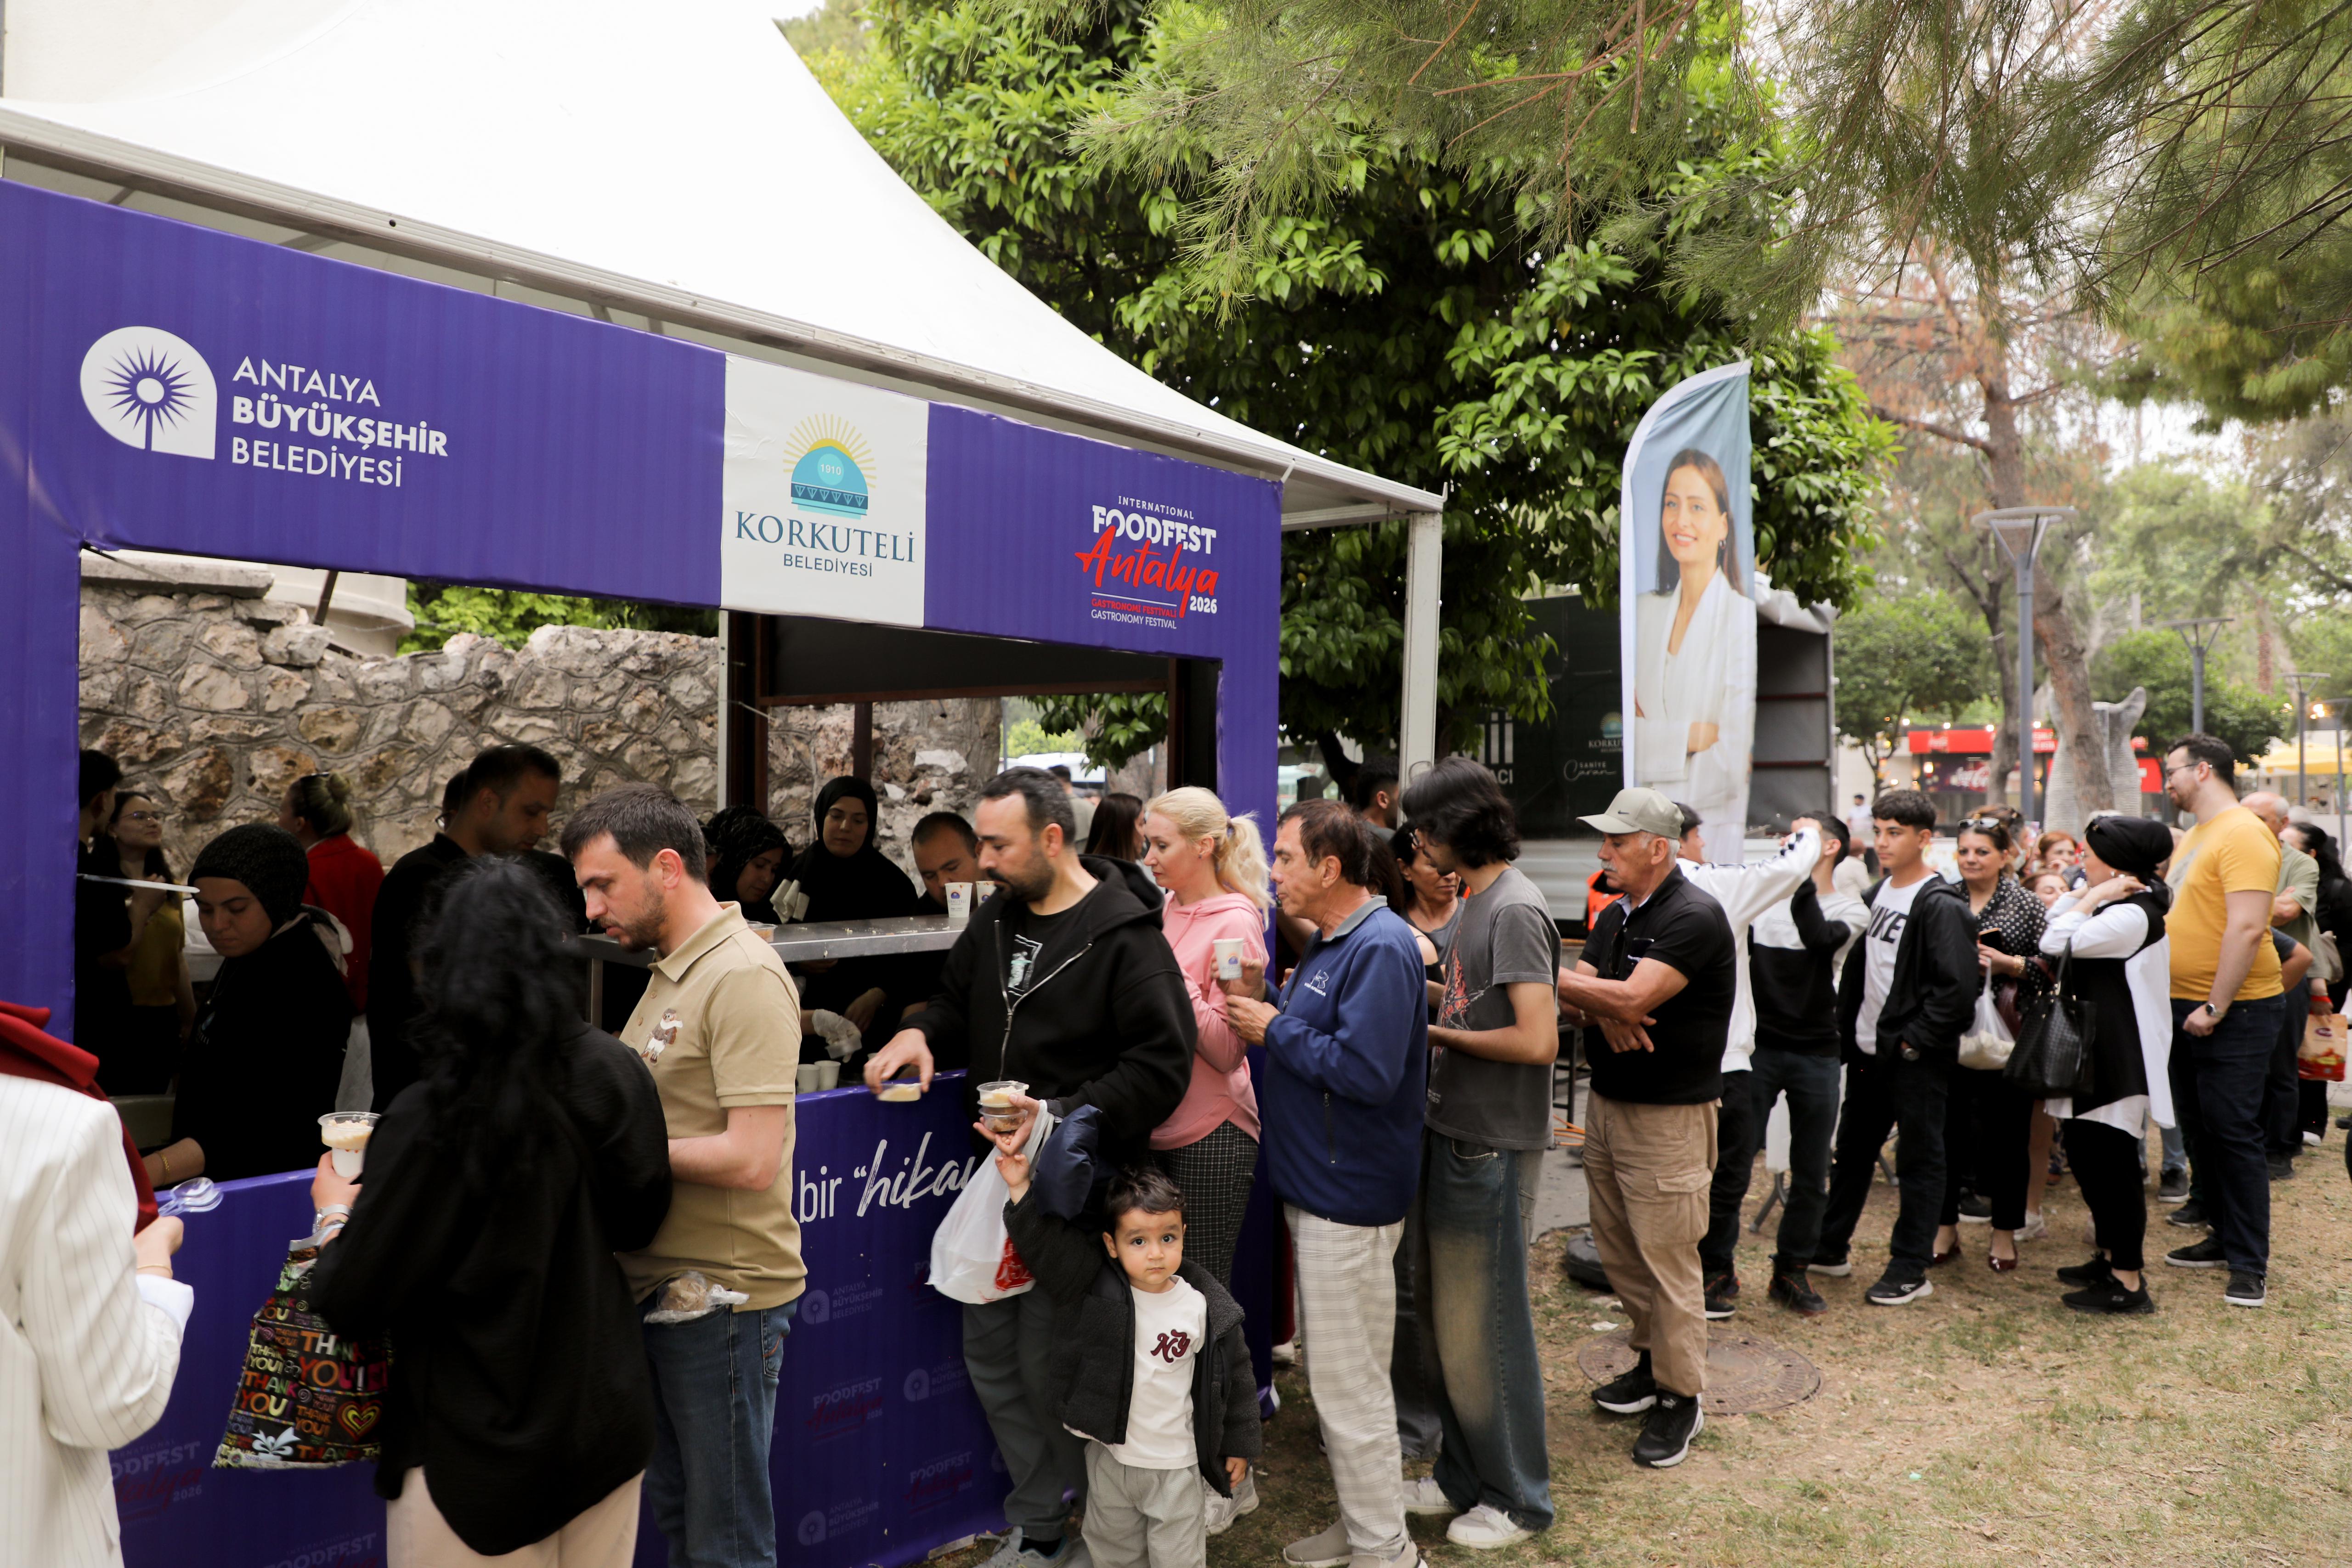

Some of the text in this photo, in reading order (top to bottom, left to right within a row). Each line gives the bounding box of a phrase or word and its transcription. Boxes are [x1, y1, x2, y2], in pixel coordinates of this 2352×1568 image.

[232, 356, 381, 407] ANTALYA
[232, 393, 448, 457] BÜYÜKŞEHİR
[232, 437, 402, 487] BELEDİYESİ
[820, 464, 842, 475] 1910
[1119, 496, 1194, 519] INTERNATIONAL
[735, 511, 916, 563] KORKUTELİ
[1092, 505, 1217, 555] FOODFEST
[783, 553, 872, 577] BELEDİYESİ
[1074, 525, 1220, 619] Antalya
[1091, 598, 1177, 618] GASTRONOMİ FESTİVALİ
[1189, 595, 1217, 614] 2026
[1091, 609, 1177, 629] GASTRONOMY FESTIVAL
[1588, 739, 1623, 748] KORKU
[799, 1166, 842, 1223] bir
[832, 1280, 866, 1297] ANTALYA
[832, 1286, 883, 1309] BÜYÜKŞEHİR
[832, 1300, 872, 1320] BELEDİYESİ
[249, 1354, 285, 1375] YOU!
[299, 1356, 365, 1392] YOU!
[244, 1370, 299, 1398] THANK
[813, 1377, 882, 1410] FOODFEST
[240, 1389, 294, 1419] YOU!
[296, 1404, 333, 1424] THANK
[295, 1416, 331, 1438] YOU!
[110, 1441, 201, 1480] ODFEST
[910, 1451, 972, 1484] FOODFEST
[173, 1484, 203, 1503] 2026
[829, 1496, 863, 1515] ANTALYA
